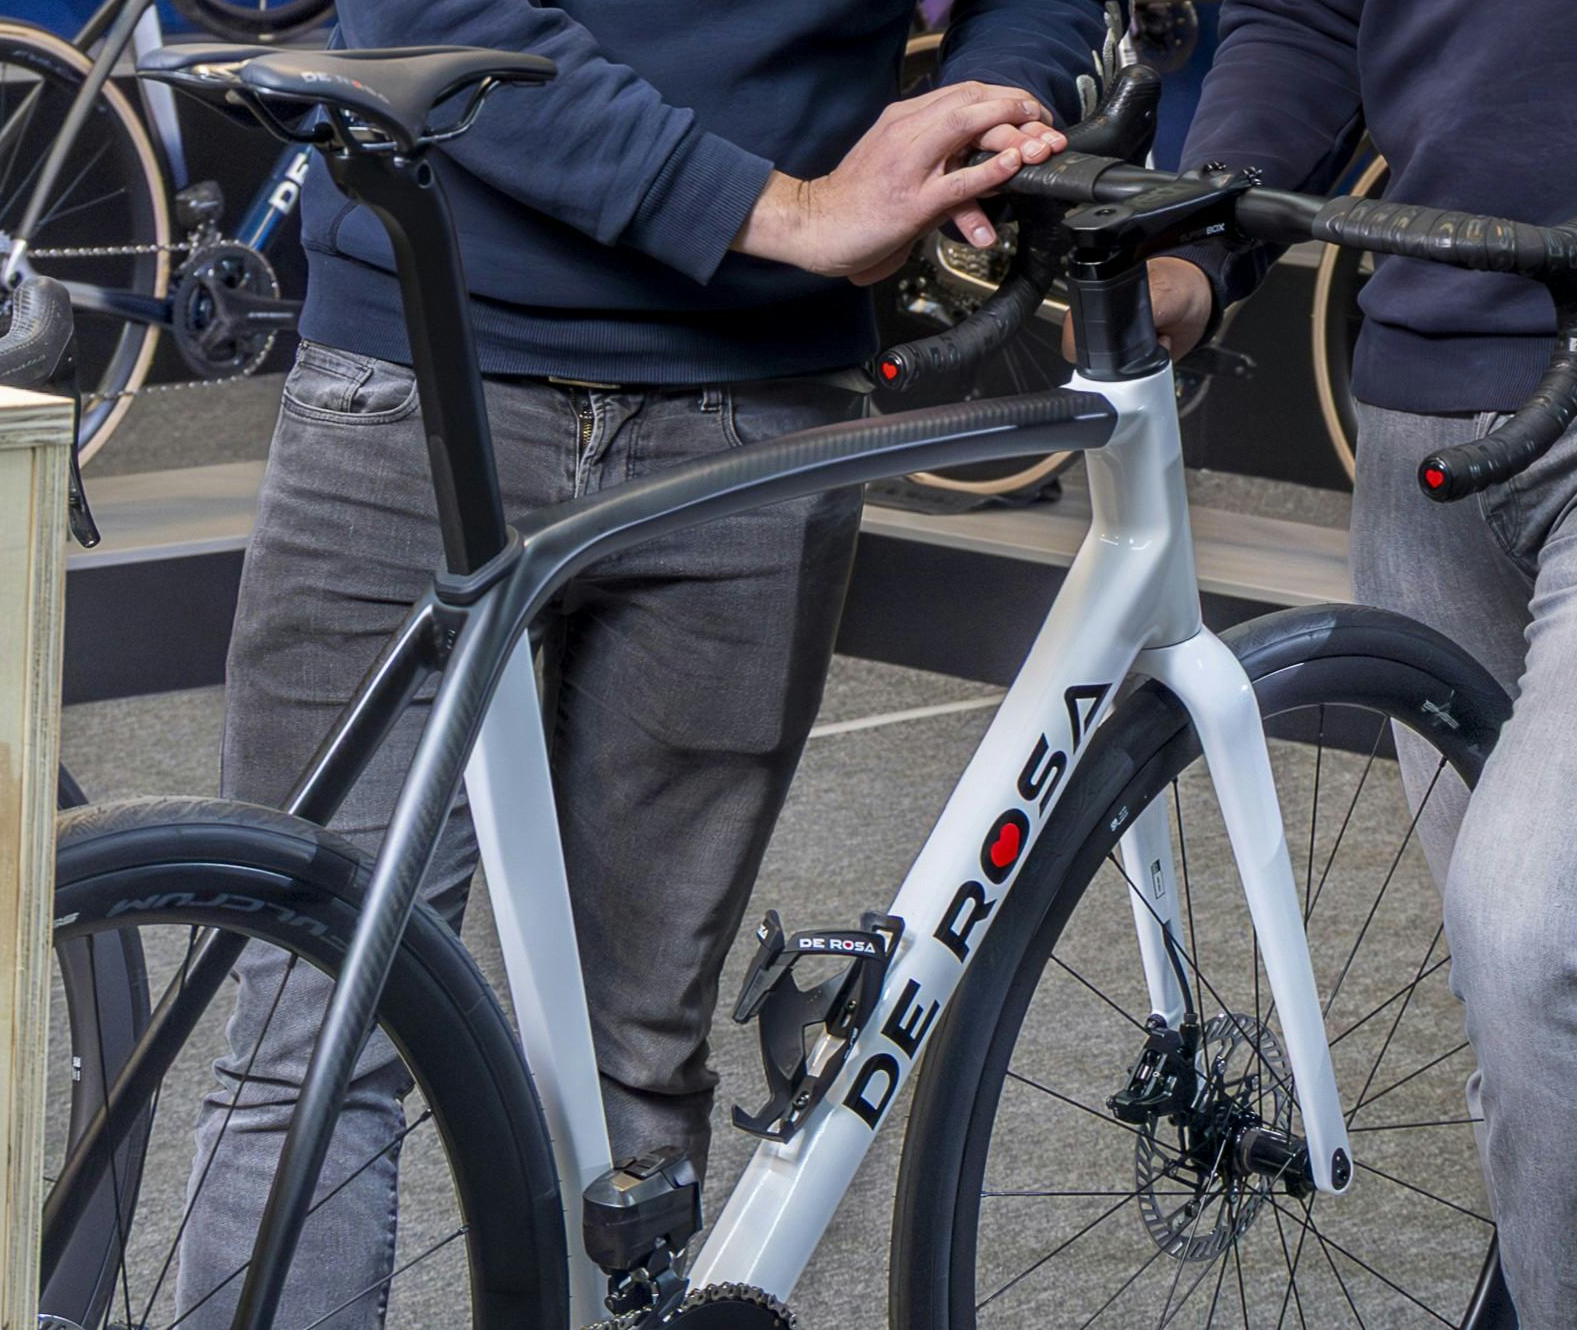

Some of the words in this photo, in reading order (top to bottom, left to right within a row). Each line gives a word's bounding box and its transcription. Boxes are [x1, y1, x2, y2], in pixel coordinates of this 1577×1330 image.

[798, 935, 826, 949] DE
[828, 938, 877, 956] ROSA
[842, 978, 942, 1132] DE
[933, 681, 1114, 965] ROSA
